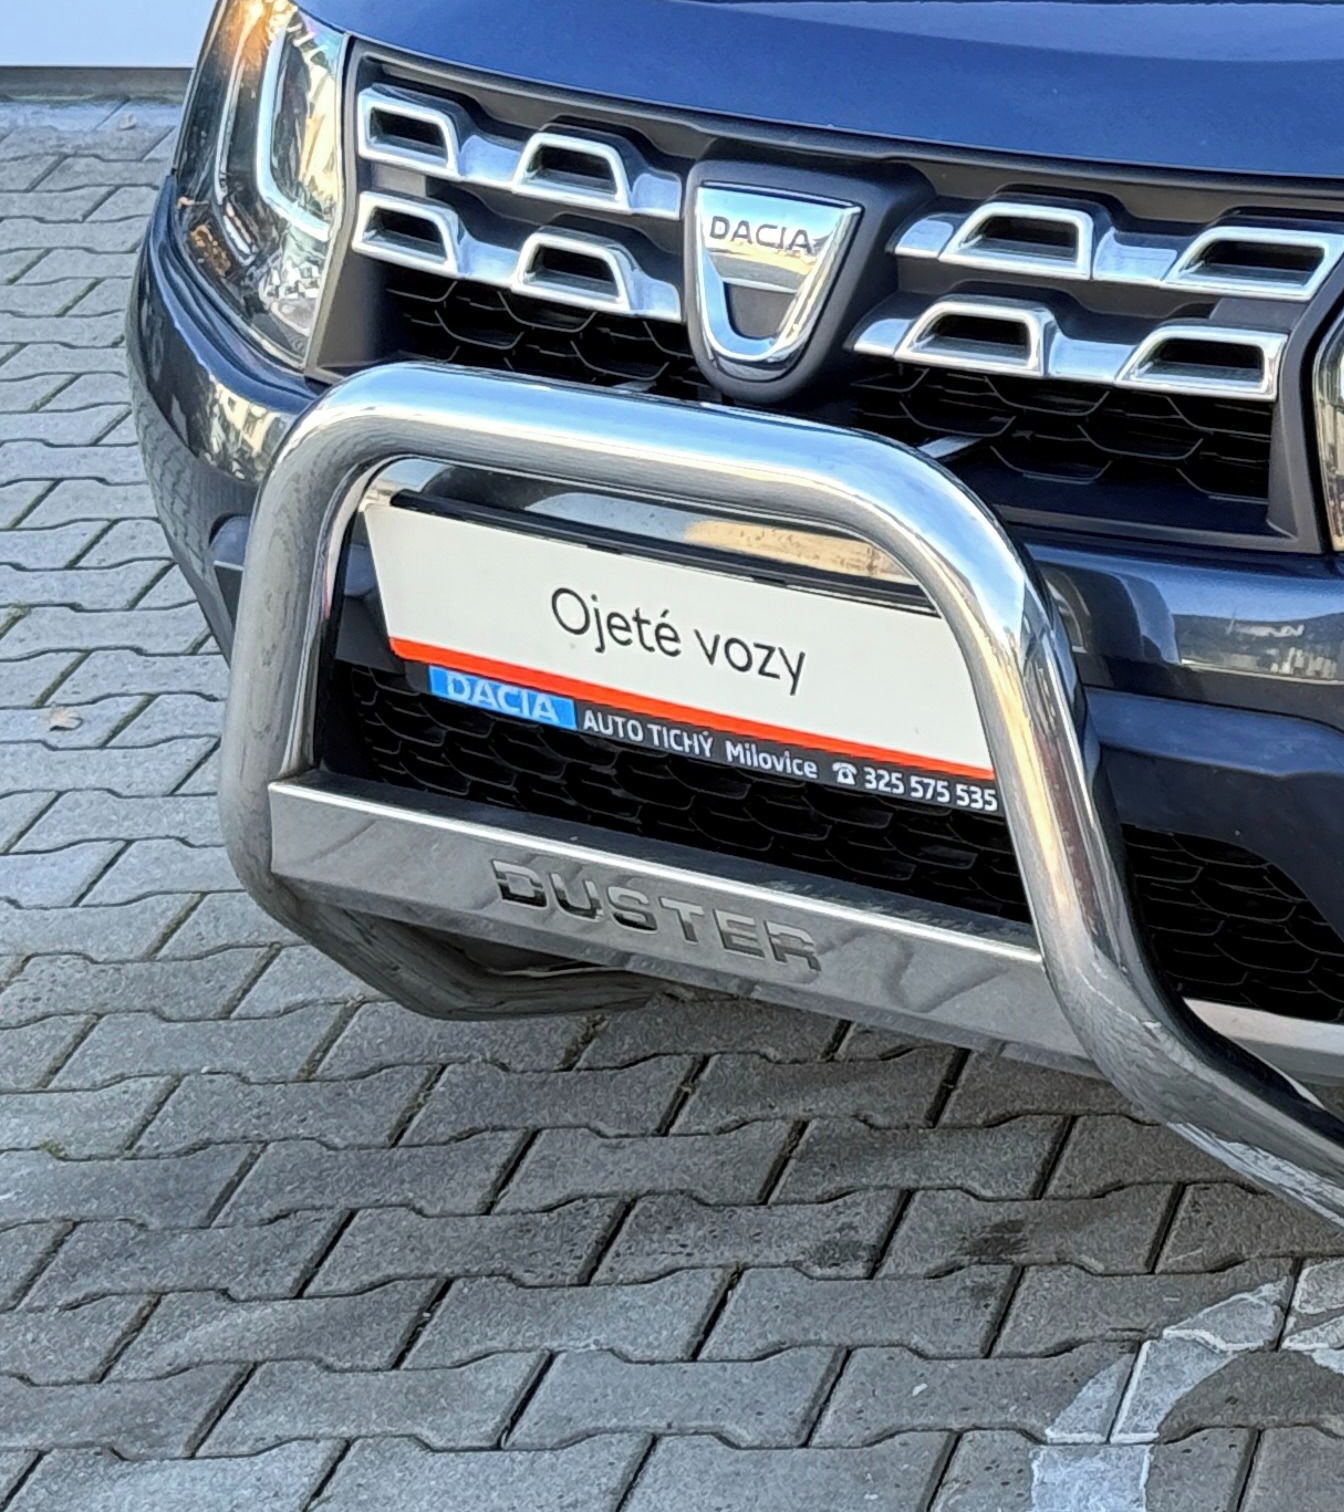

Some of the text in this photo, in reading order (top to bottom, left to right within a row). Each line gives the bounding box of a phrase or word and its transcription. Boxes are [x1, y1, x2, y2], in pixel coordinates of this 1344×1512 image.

[709, 215, 813, 254] DACIA
[551, 587, 806, 696] Ojeté vozy
[446, 669, 560, 724] DACIA
[583, 710, 999, 813] AUTO TICHÝ Milovice 325 575 535
[490, 858, 822, 973] DUSTER
